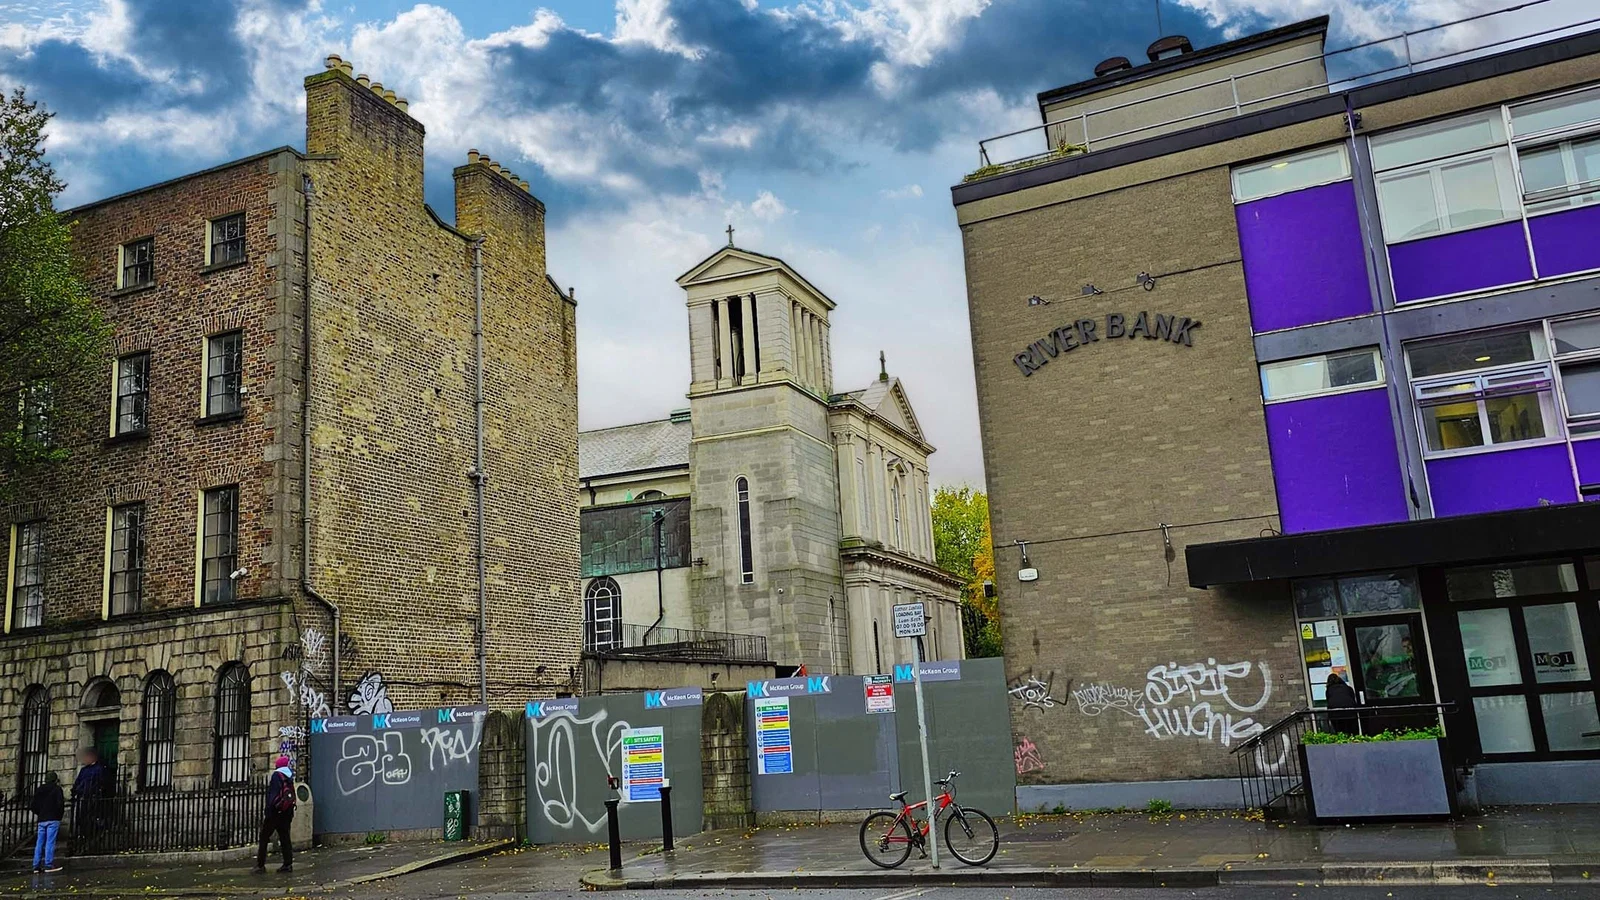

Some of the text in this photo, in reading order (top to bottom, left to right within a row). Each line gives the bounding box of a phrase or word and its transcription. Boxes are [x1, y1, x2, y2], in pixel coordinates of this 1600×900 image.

[1013, 311, 1202, 377] RIVER BANK
[769, 684, 790, 692] McKeon
[687, 692, 701, 700] Group
[564, 703, 578, 711] Group
[408, 715, 421, 723] Group
[344, 720, 356, 728] Group
